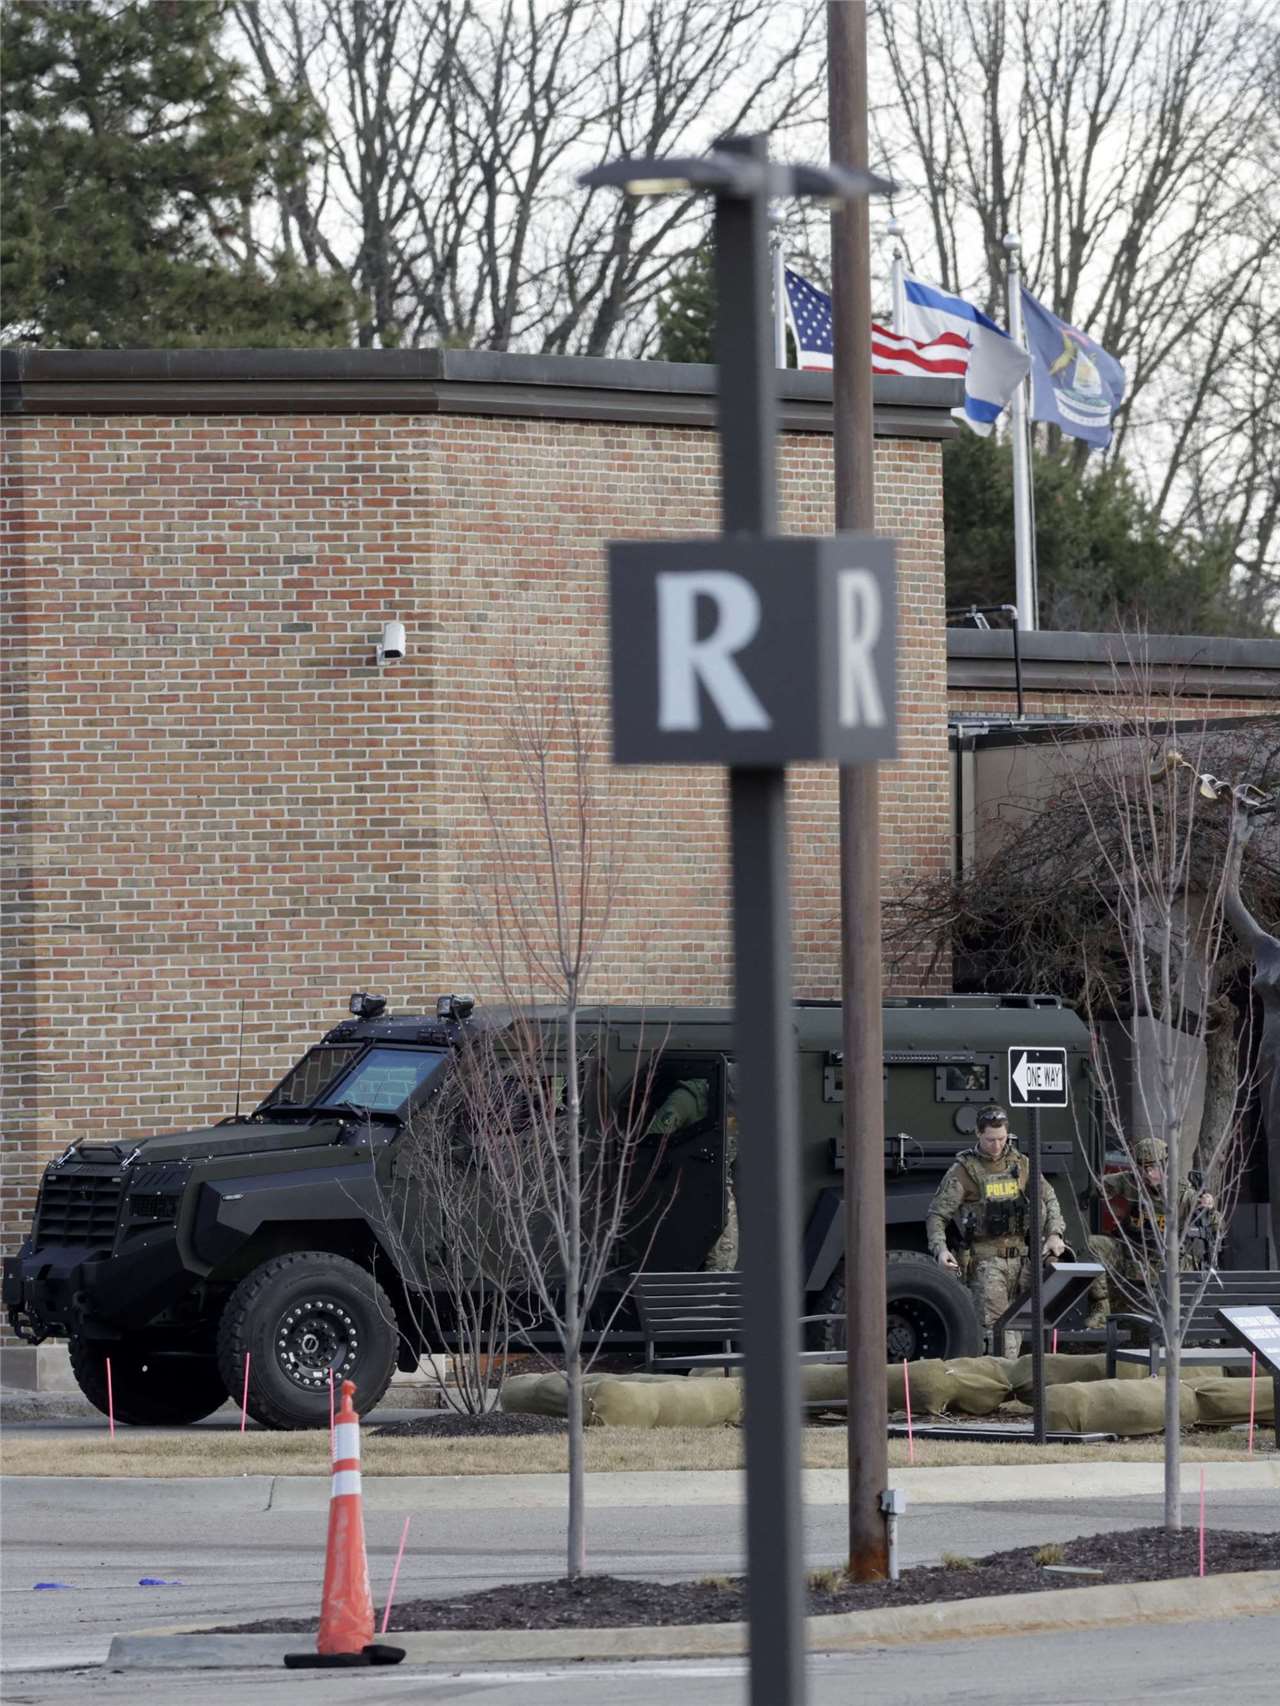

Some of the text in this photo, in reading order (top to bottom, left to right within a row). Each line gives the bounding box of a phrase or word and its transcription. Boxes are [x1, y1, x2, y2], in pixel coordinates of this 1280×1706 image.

[656, 569, 772, 732] R
[836, 568, 887, 729] R
[1026, 1066, 1061, 1088] ONE WAY
